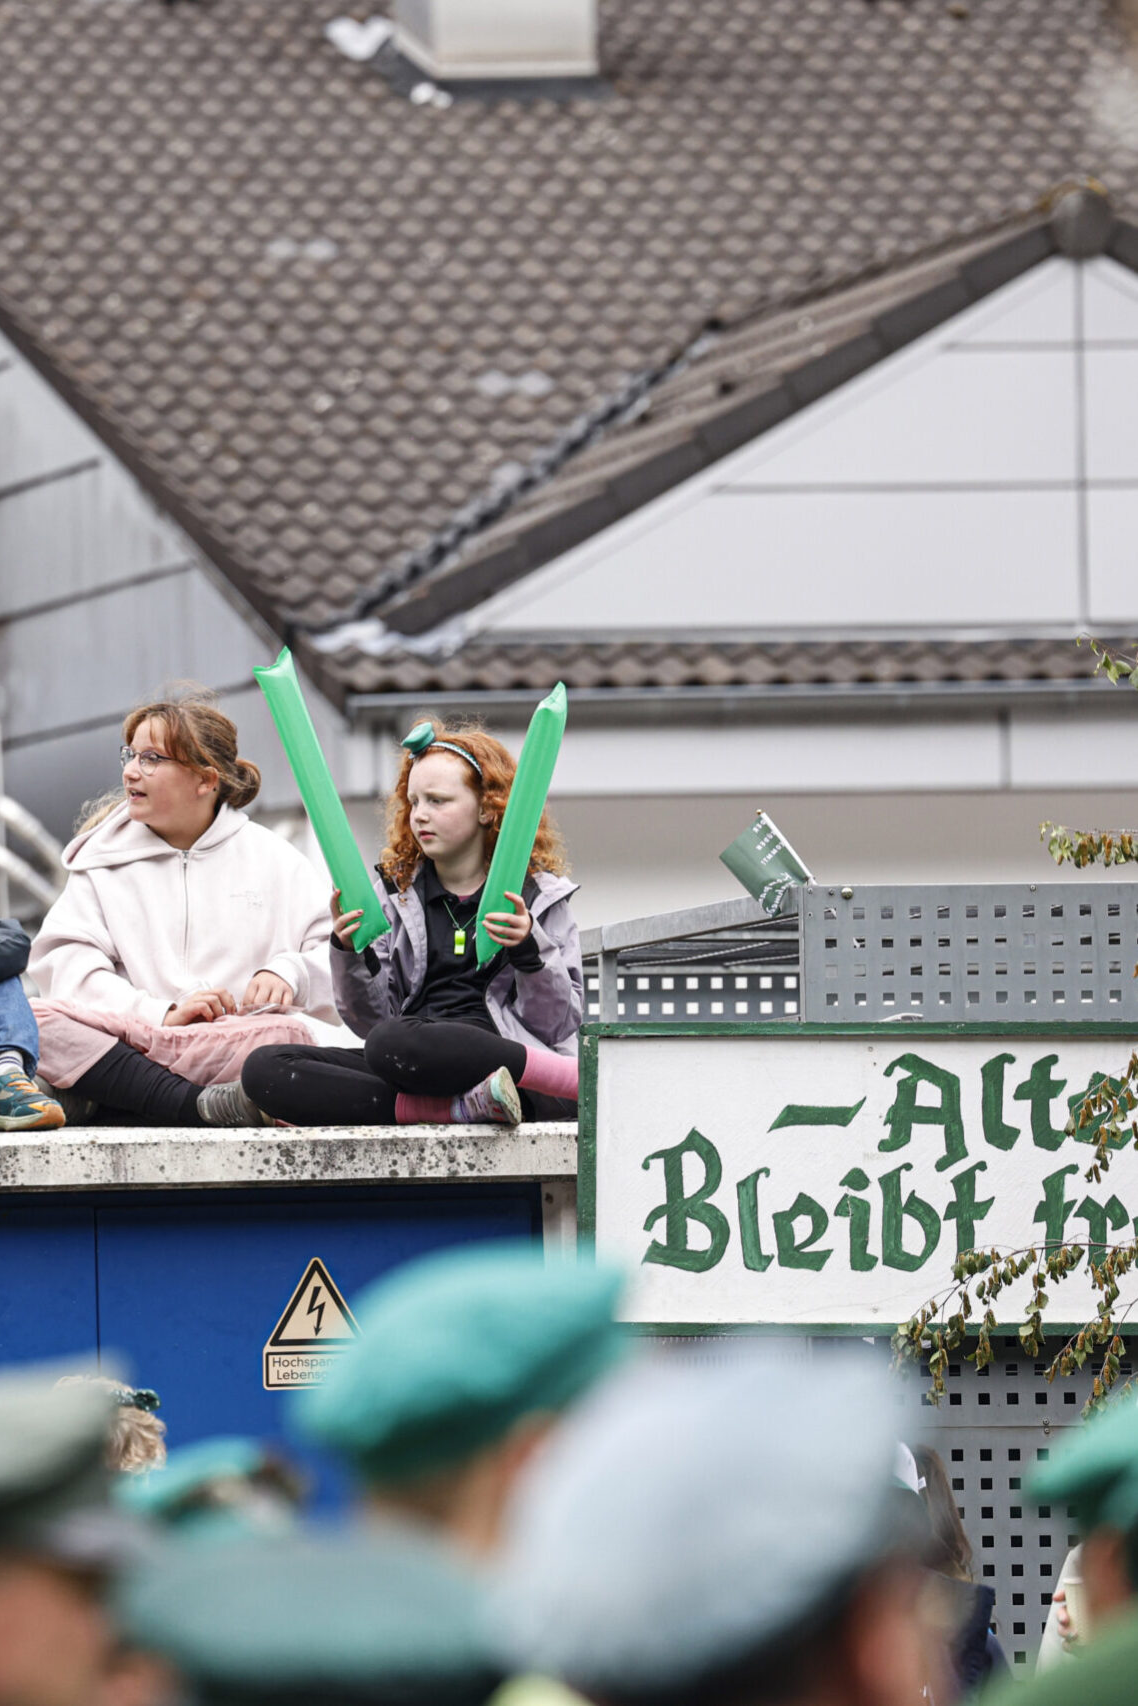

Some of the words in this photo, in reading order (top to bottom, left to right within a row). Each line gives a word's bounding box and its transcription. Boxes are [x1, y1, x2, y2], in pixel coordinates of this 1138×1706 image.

[641, 1127, 996, 1273] Bleibt
[1033, 1163, 1138, 1272] fr
[272, 1355, 337, 1370] Hochspan
